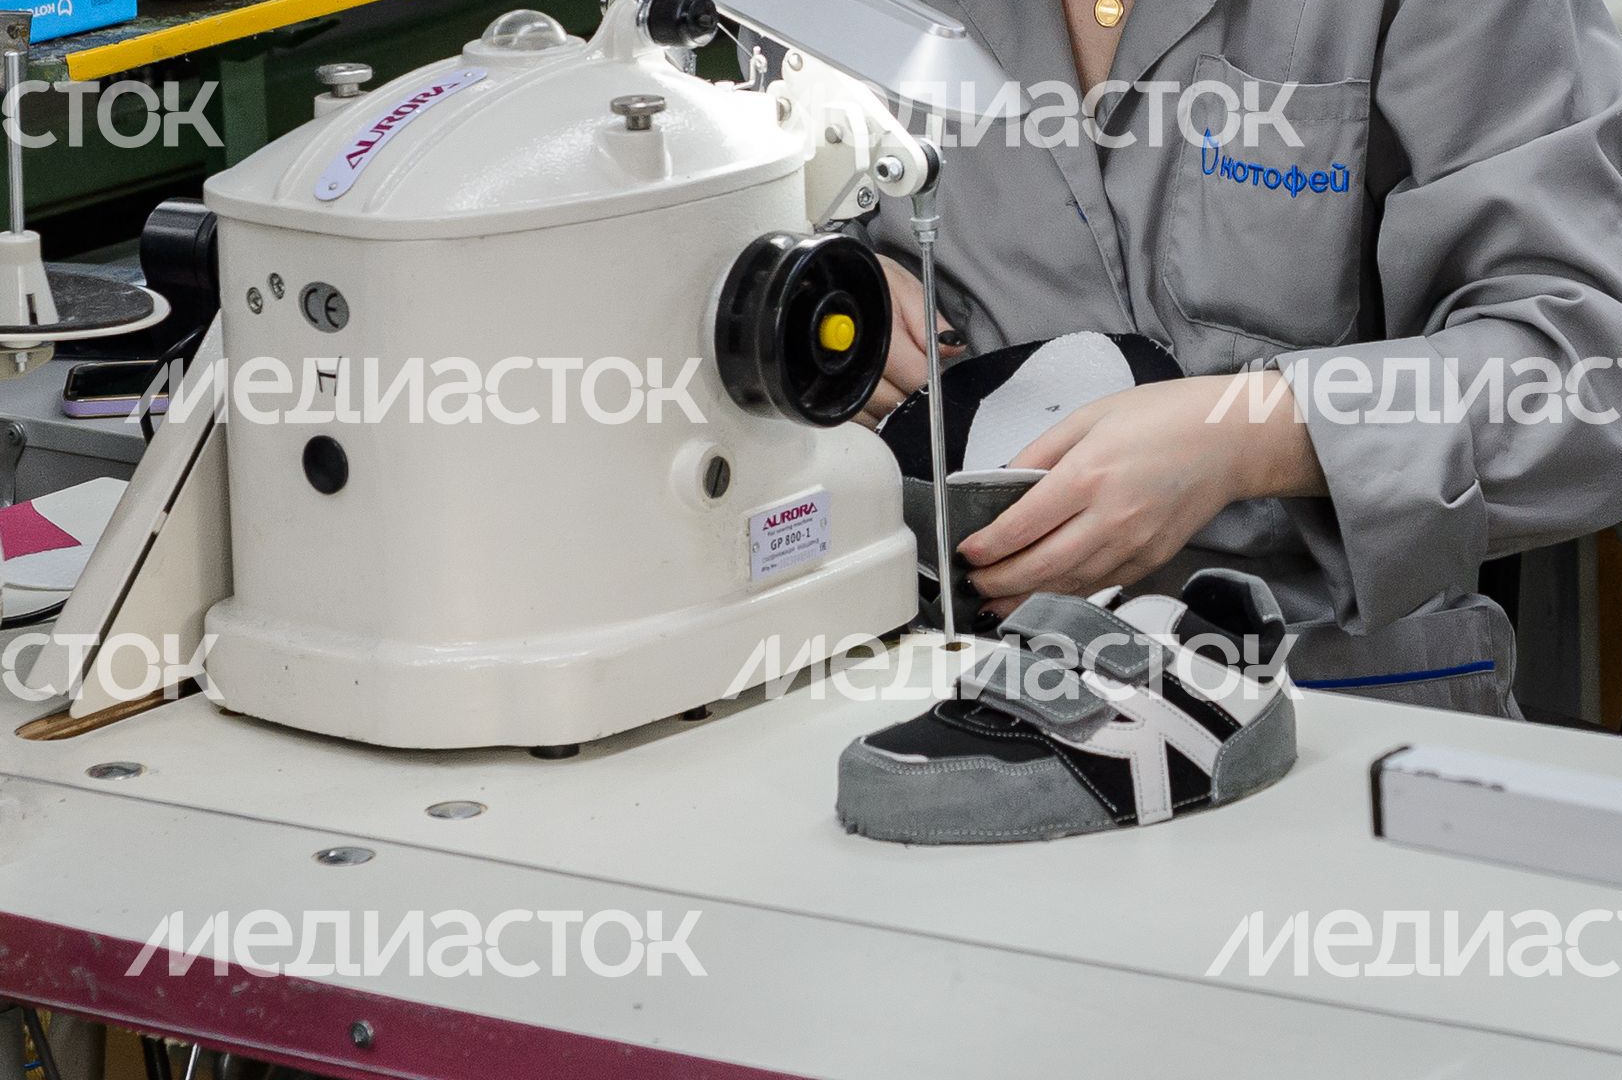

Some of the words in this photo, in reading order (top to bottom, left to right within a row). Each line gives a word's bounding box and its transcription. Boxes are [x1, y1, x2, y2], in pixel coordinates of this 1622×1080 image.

[345, 82, 461, 170] AURORA
[1220, 155, 1350, 199] котофей
[762, 502, 819, 532] AURORA
[770, 536, 783, 551] GP
[785, 527, 811, 546] 800-1
